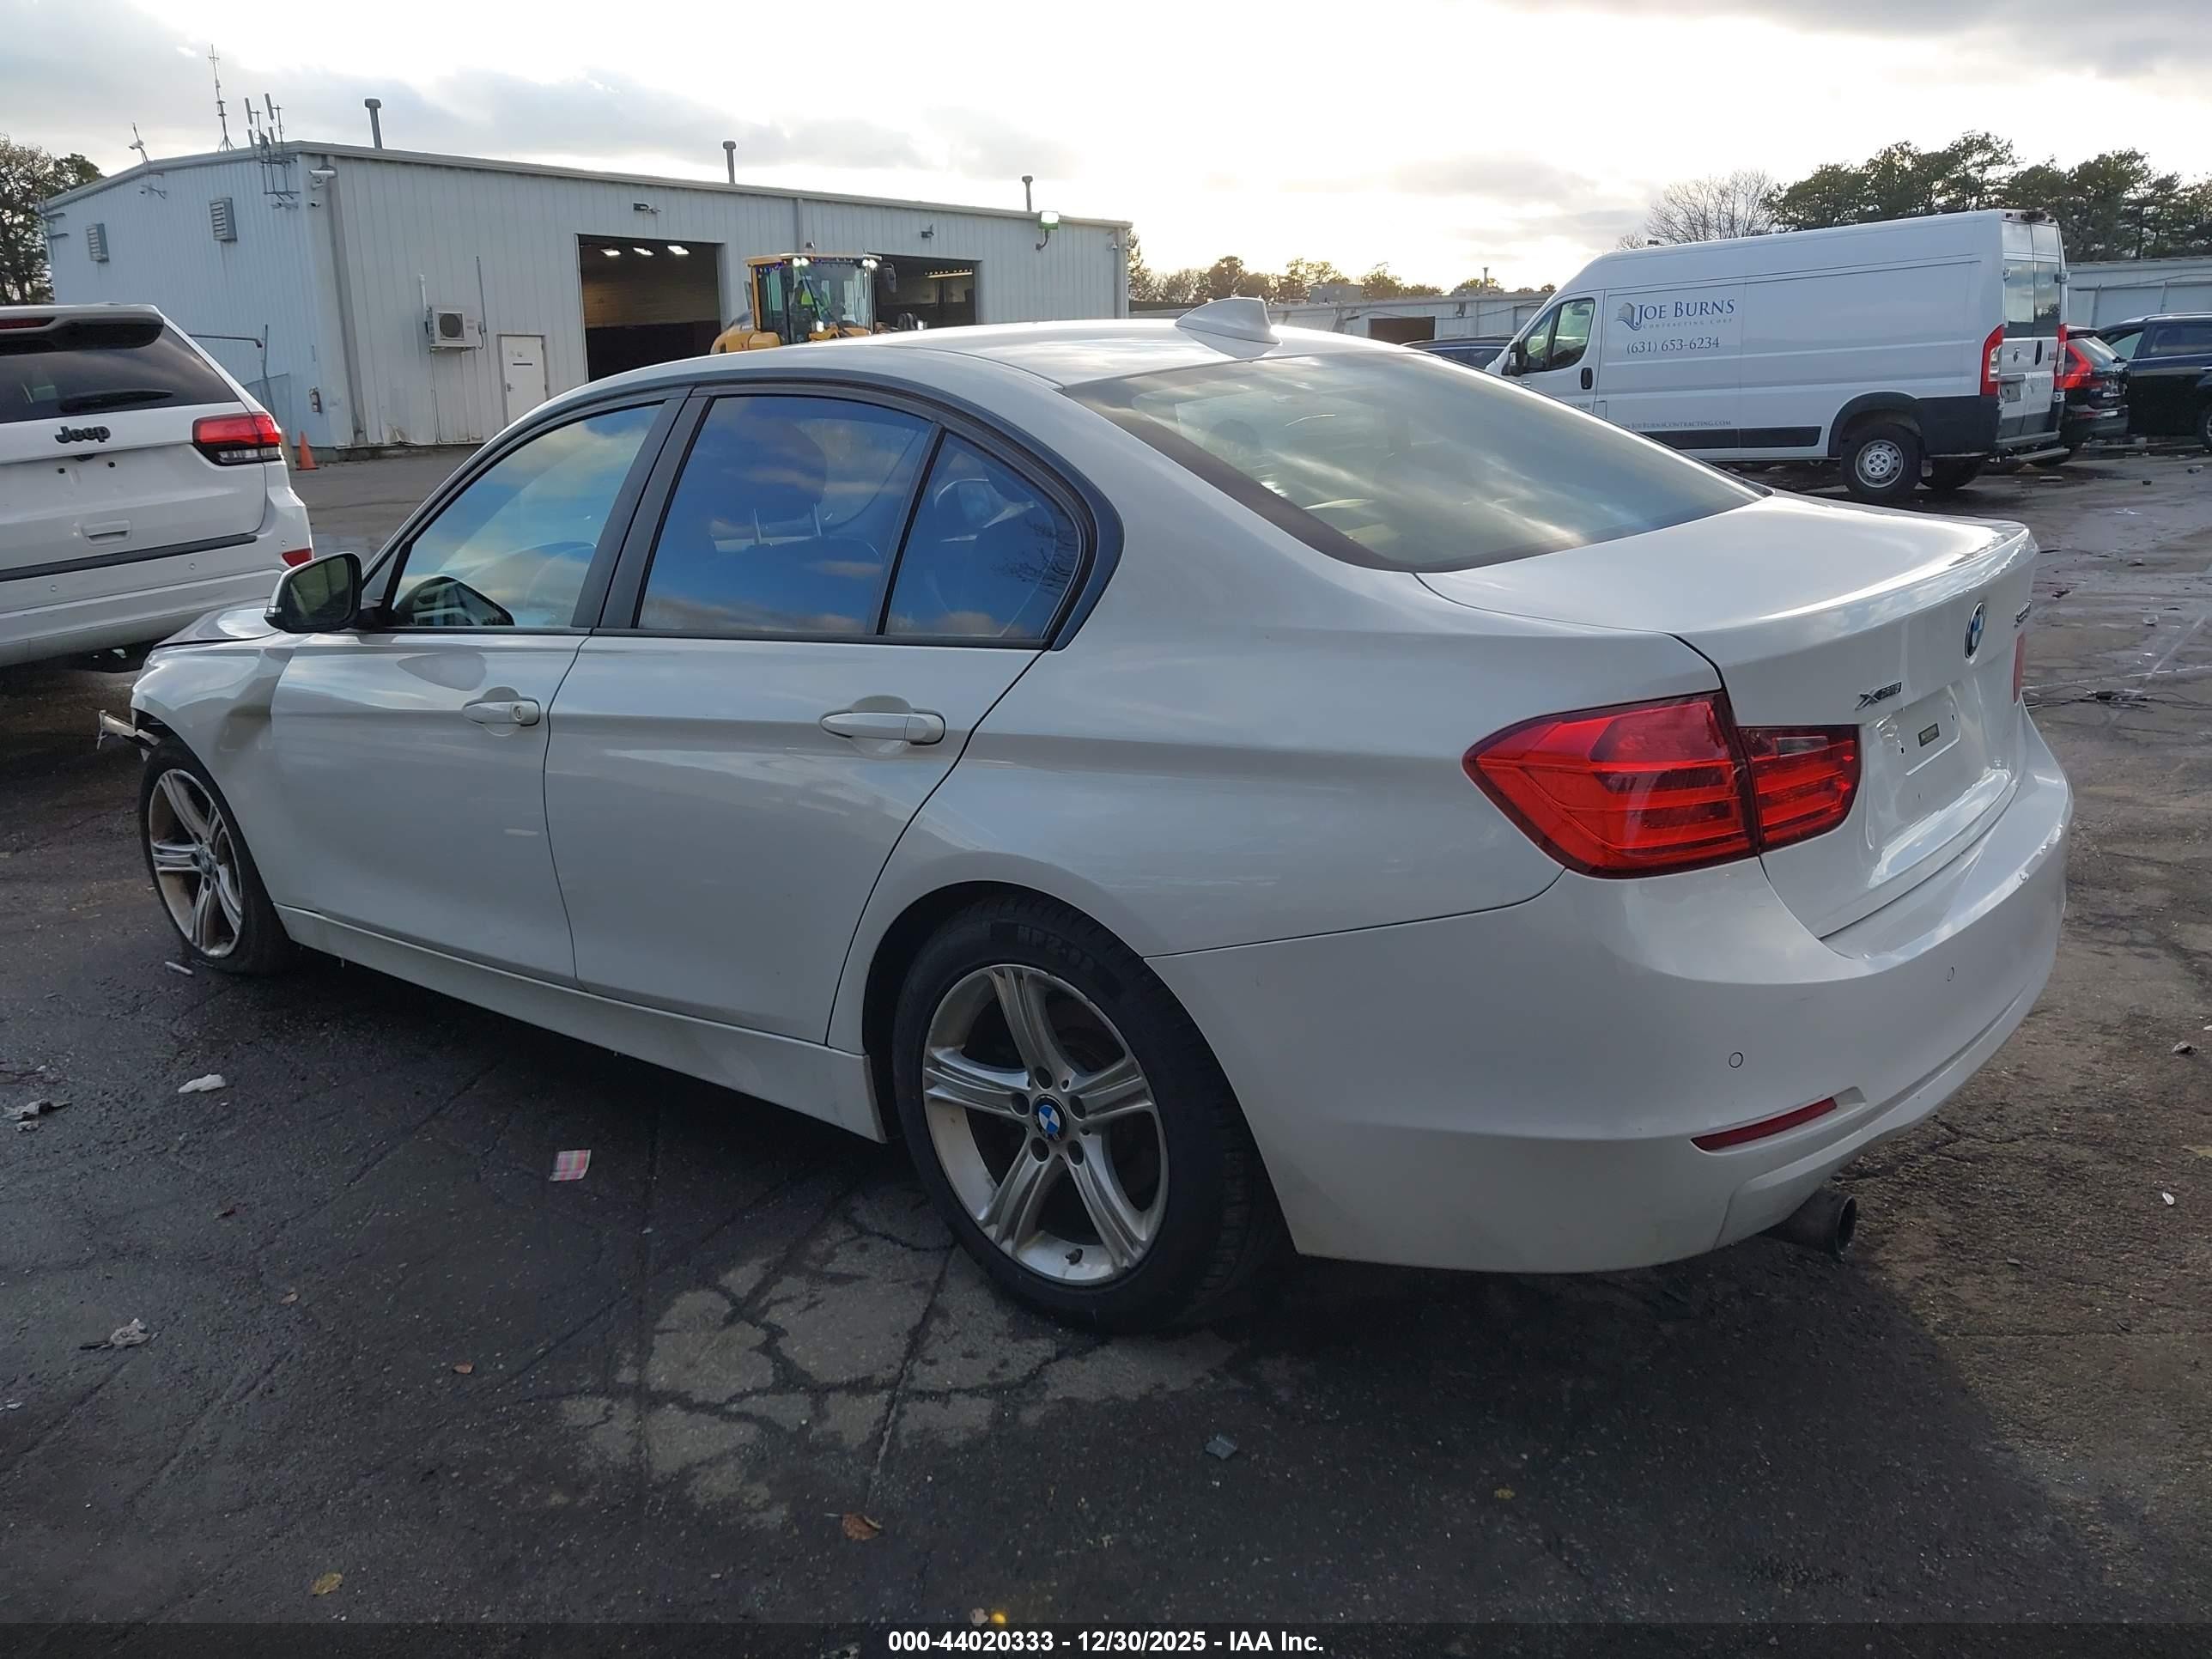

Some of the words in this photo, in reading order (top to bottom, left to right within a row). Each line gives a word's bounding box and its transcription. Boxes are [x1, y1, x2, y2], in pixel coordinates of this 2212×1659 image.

[1635, 304, 1668, 325] JOE
[1674, 299, 1735, 319] BURNS
[1626, 340, 1657, 355] (631)
[1661, 337, 1720, 352] 653-6234
[55, 426, 111, 443] Jeep
